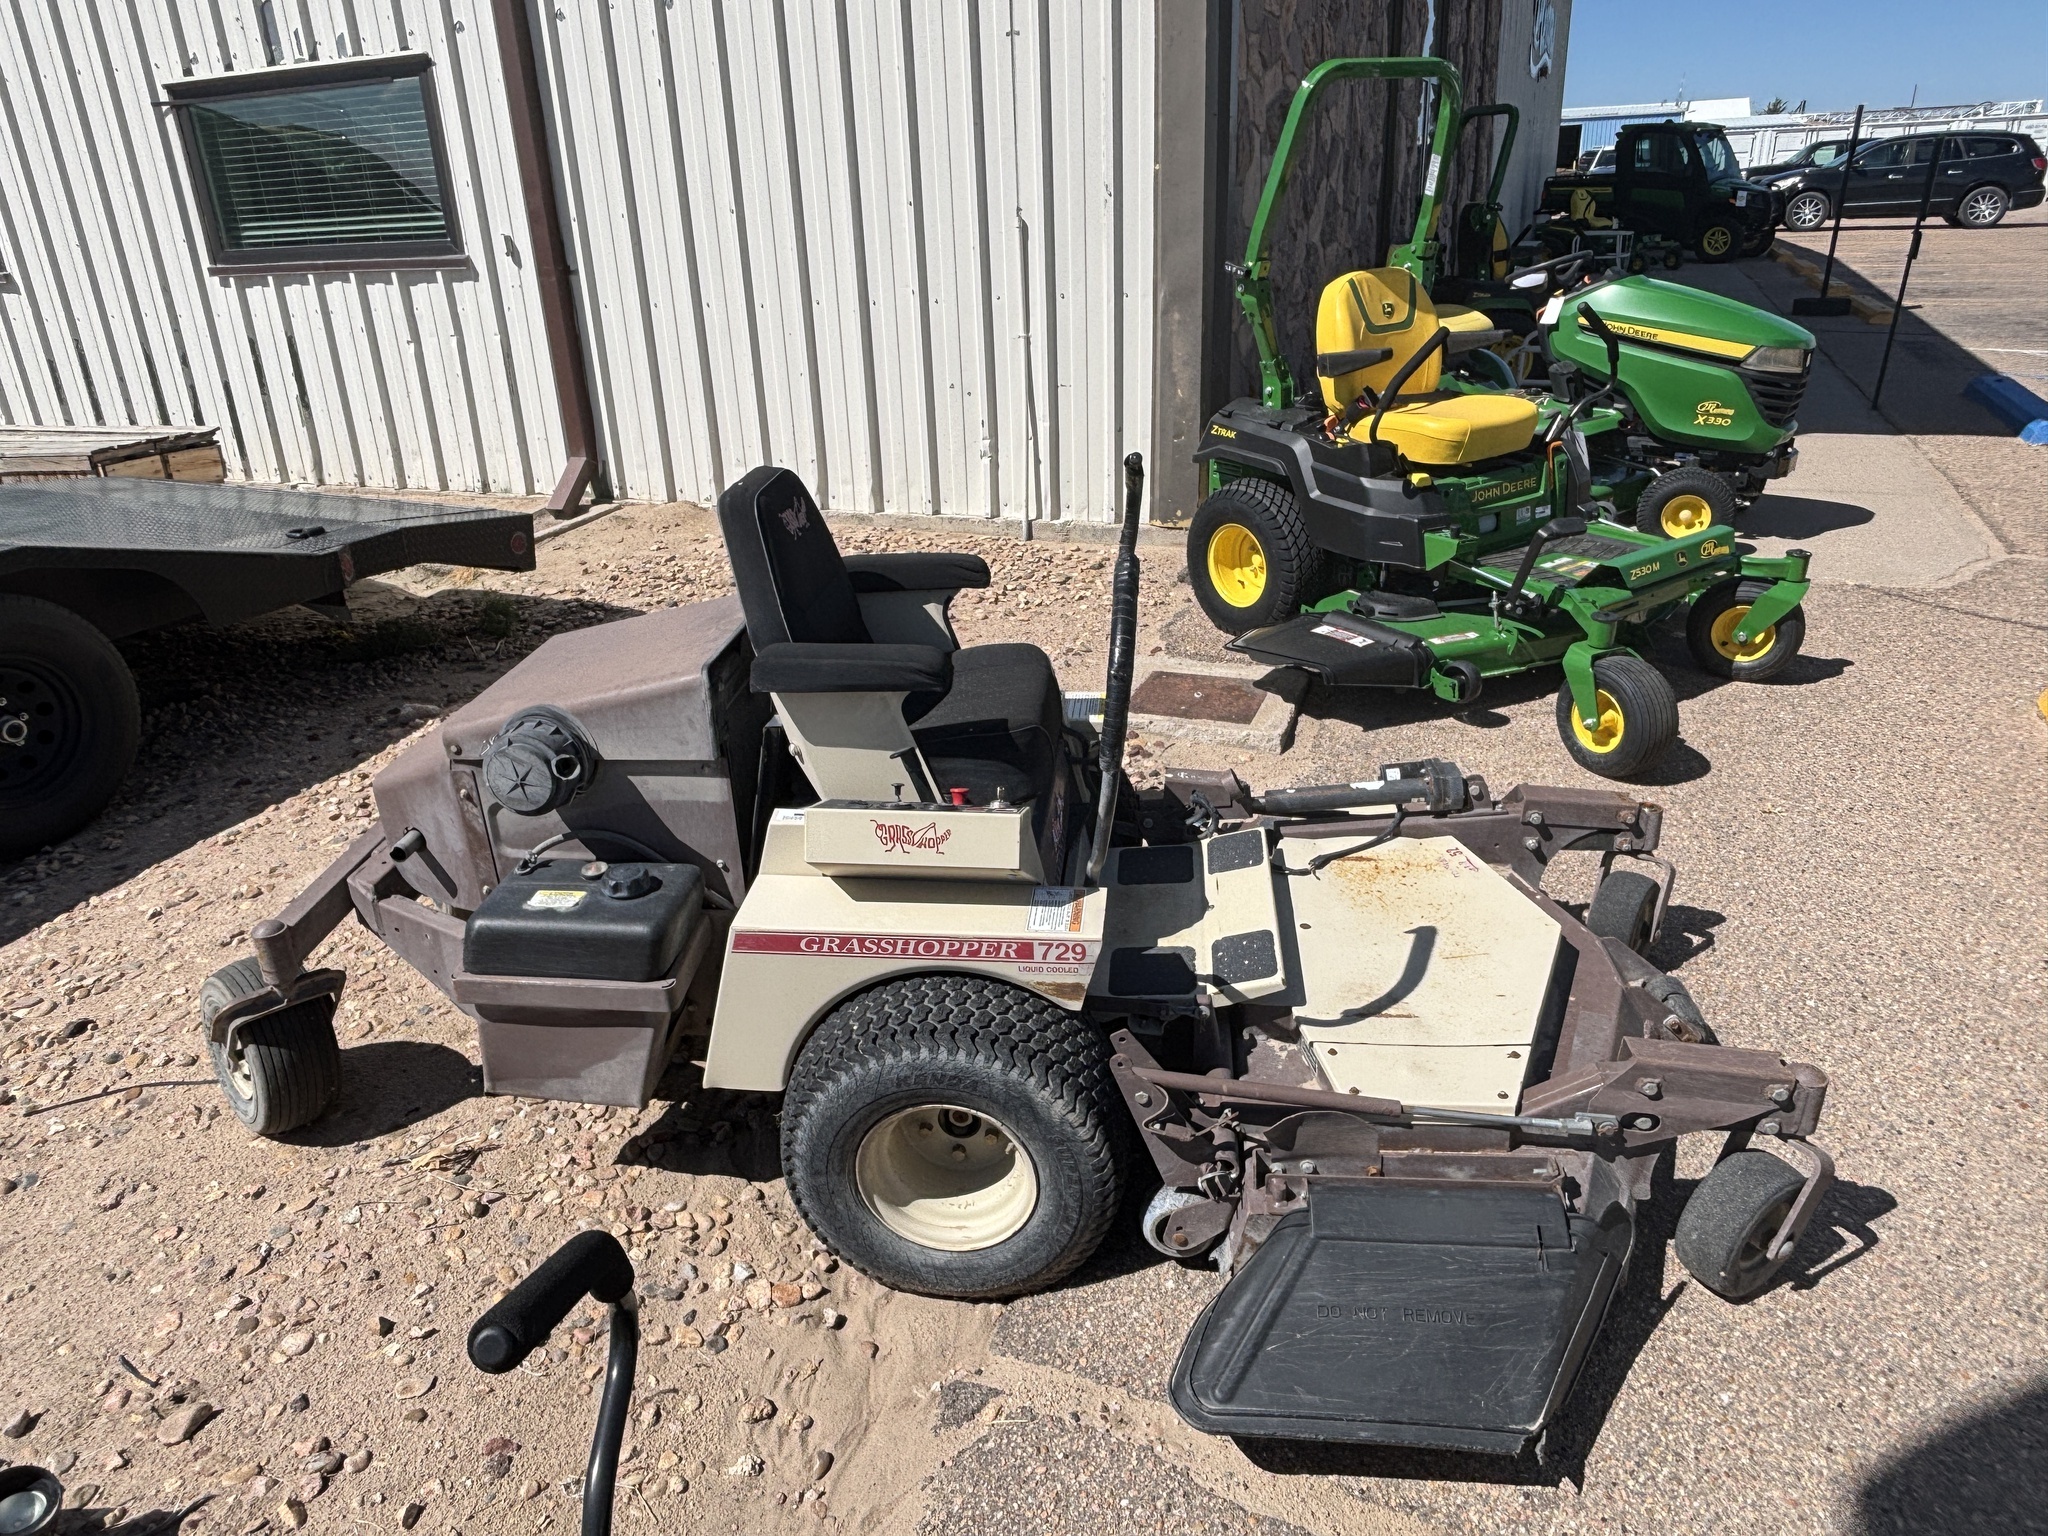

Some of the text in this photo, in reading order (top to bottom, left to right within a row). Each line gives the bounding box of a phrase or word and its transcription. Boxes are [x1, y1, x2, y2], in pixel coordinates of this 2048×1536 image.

[1628, 326, 1659, 340] DEERE
[1693, 414, 1732, 427] X330
[1211, 424, 1237, 439] ZTRAK
[1471, 477, 1537, 503] JOHN DEERE
[799, 936, 1087, 962] GRASSHOPPER 729
[1018, 965, 1079, 974] LIQUID COOLED
[1316, 1304, 1477, 1327] DO NOT REMOVE
